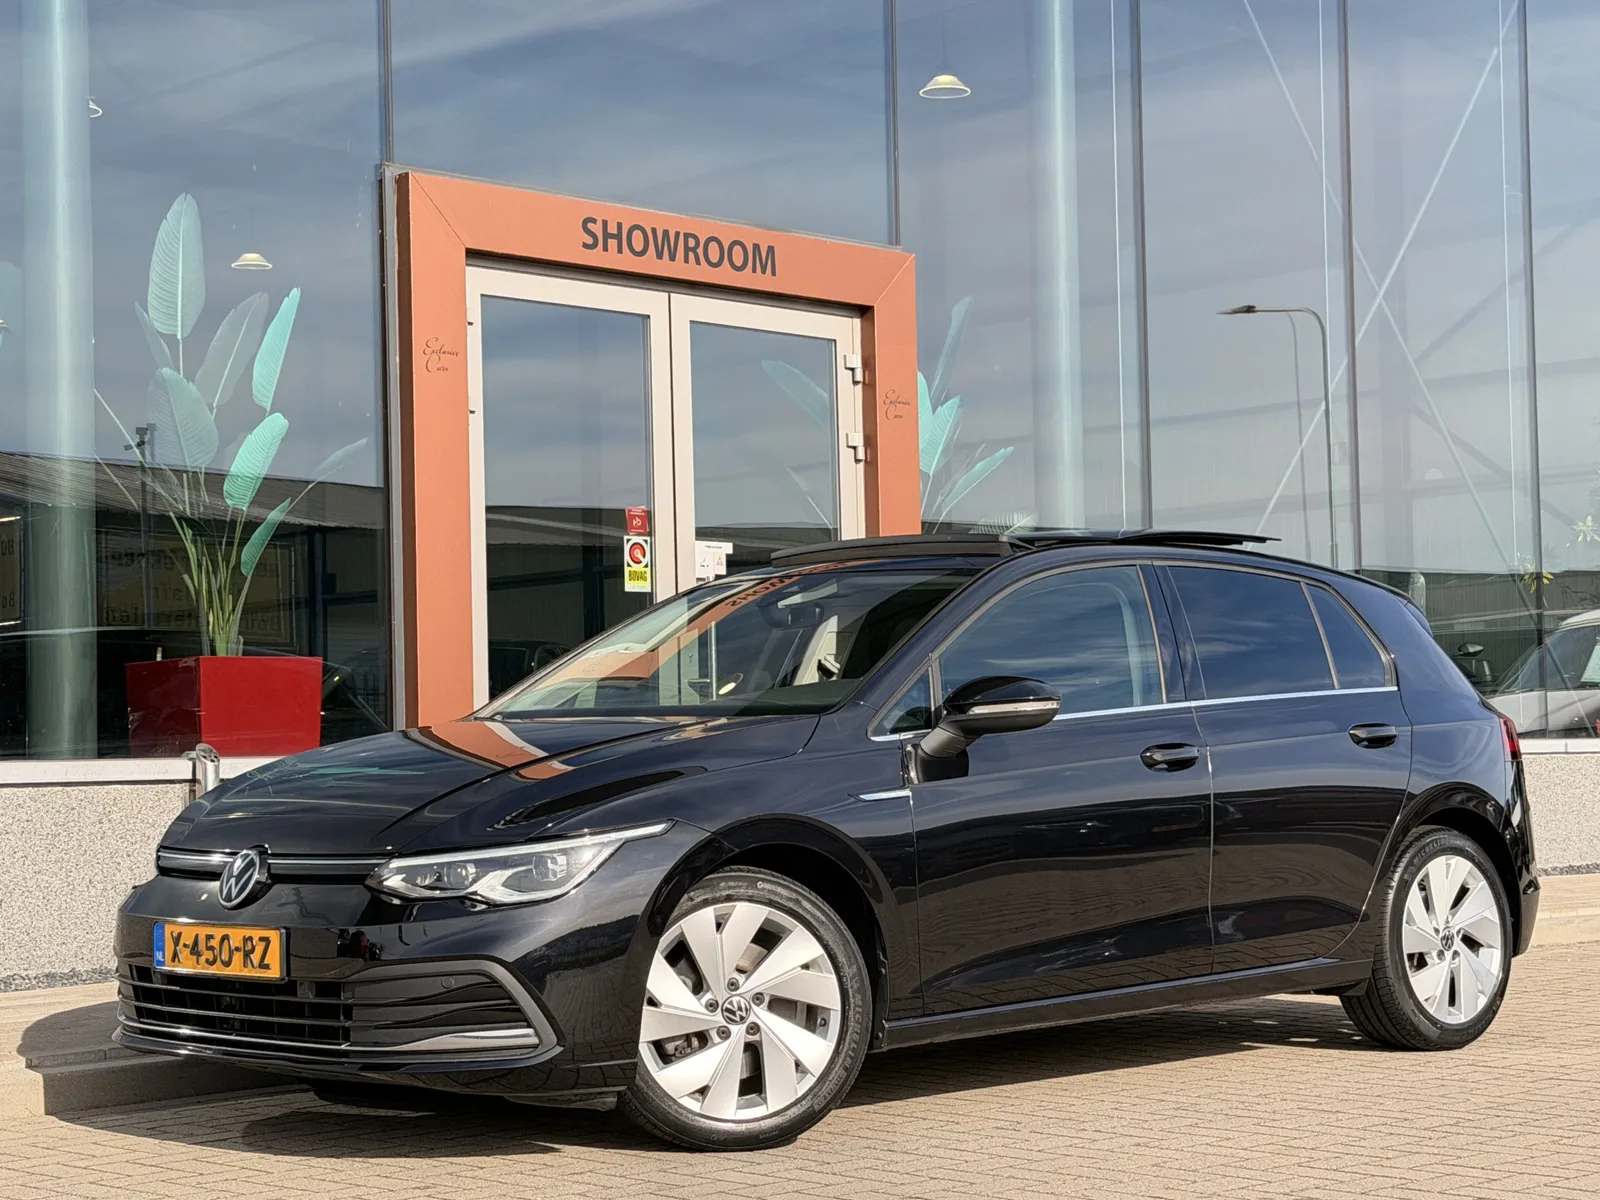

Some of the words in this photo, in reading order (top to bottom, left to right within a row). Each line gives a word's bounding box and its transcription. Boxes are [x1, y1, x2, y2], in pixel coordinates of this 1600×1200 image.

[581, 216, 777, 277] SHOWROOM
[422, 337, 460, 357] Exclusive
[425, 354, 449, 373] Cars
[628, 569, 648, 582] BOVAG
[156, 950, 165, 962] NL
[170, 930, 272, 970] X-450-RZ
